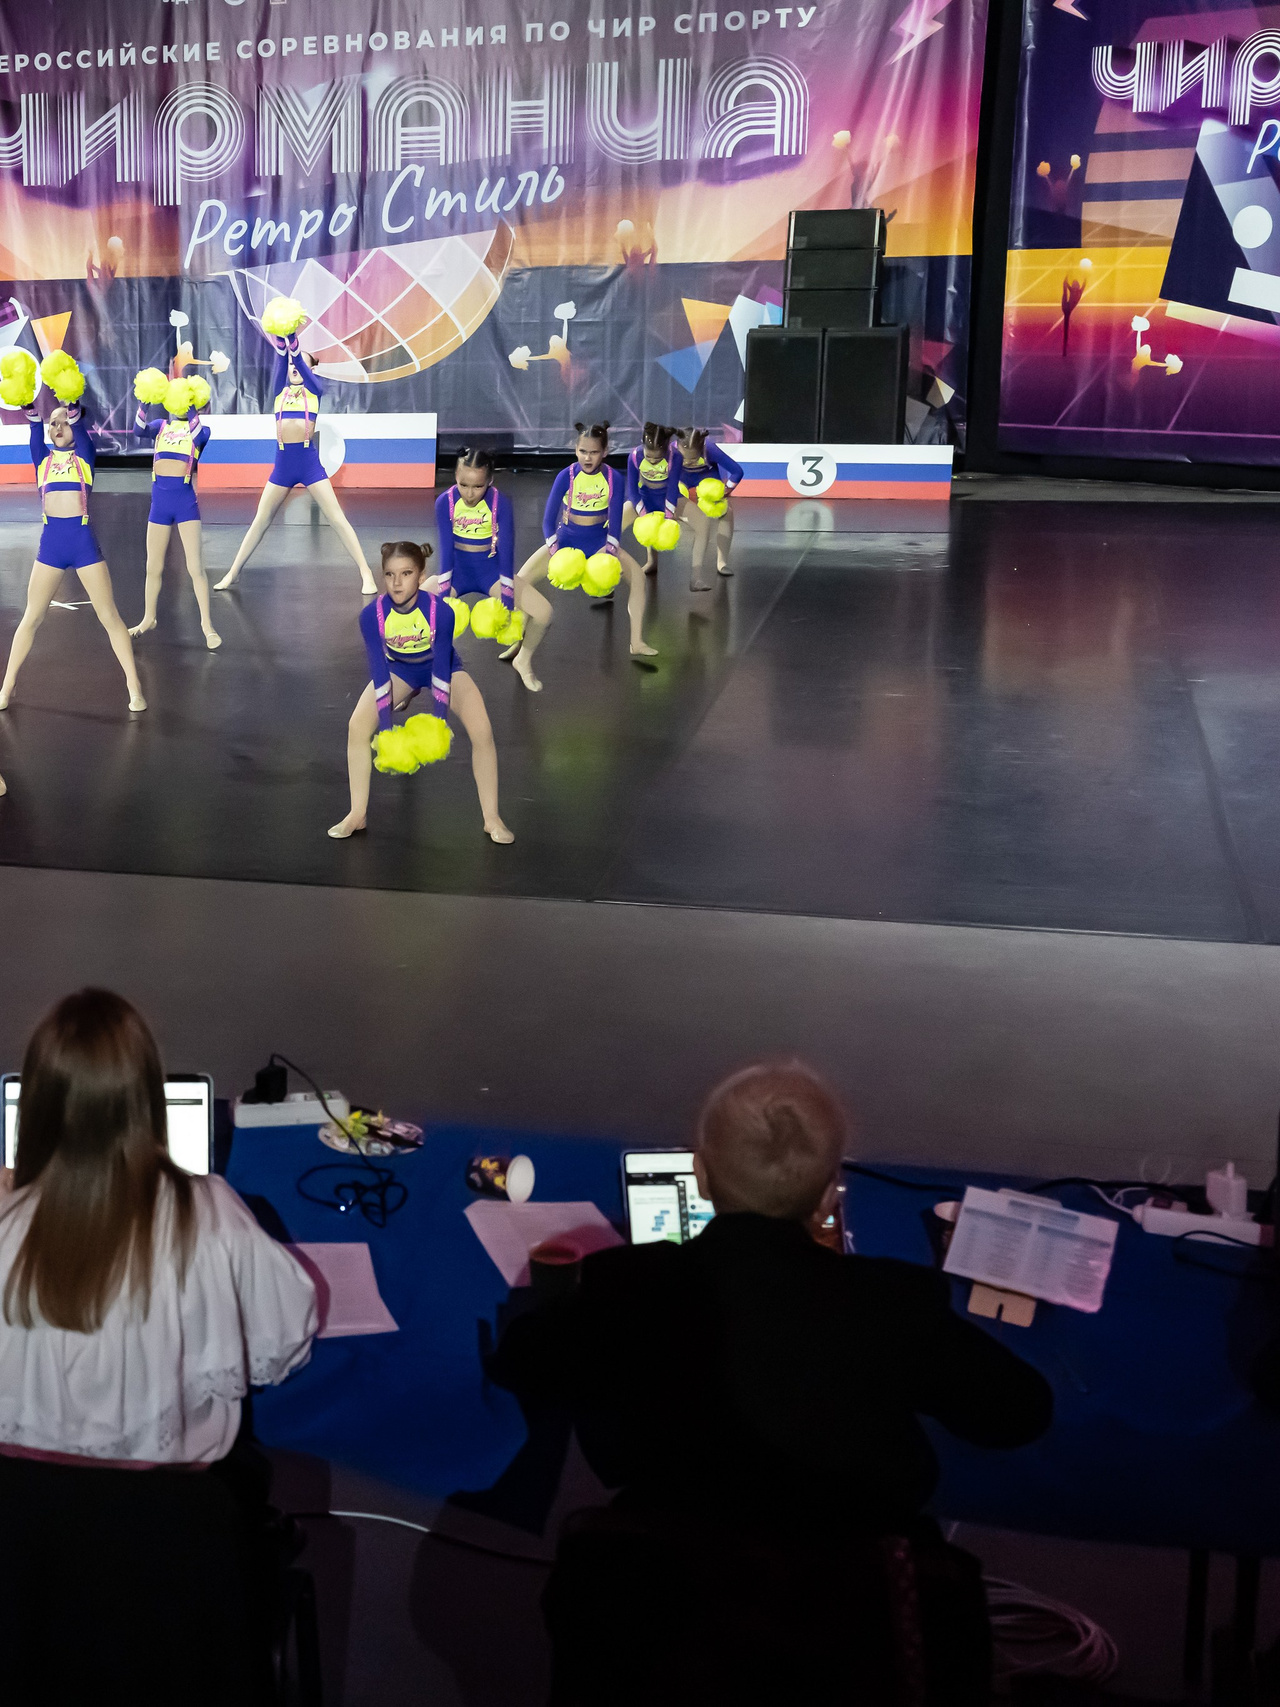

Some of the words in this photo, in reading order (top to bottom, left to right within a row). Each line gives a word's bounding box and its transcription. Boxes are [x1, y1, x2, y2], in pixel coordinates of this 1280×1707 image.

[236, 24, 507, 58] СОРЕВНОВАНИЯ
[525, 21, 570, 43] ПО
[588, 16, 657, 39] ЧИР
[674, 7, 817, 34] СПОРТУ
[183, 199, 357, 270] Ретро
[381, 164, 565, 233] Стиль
[800, 456, 824, 487] 3
